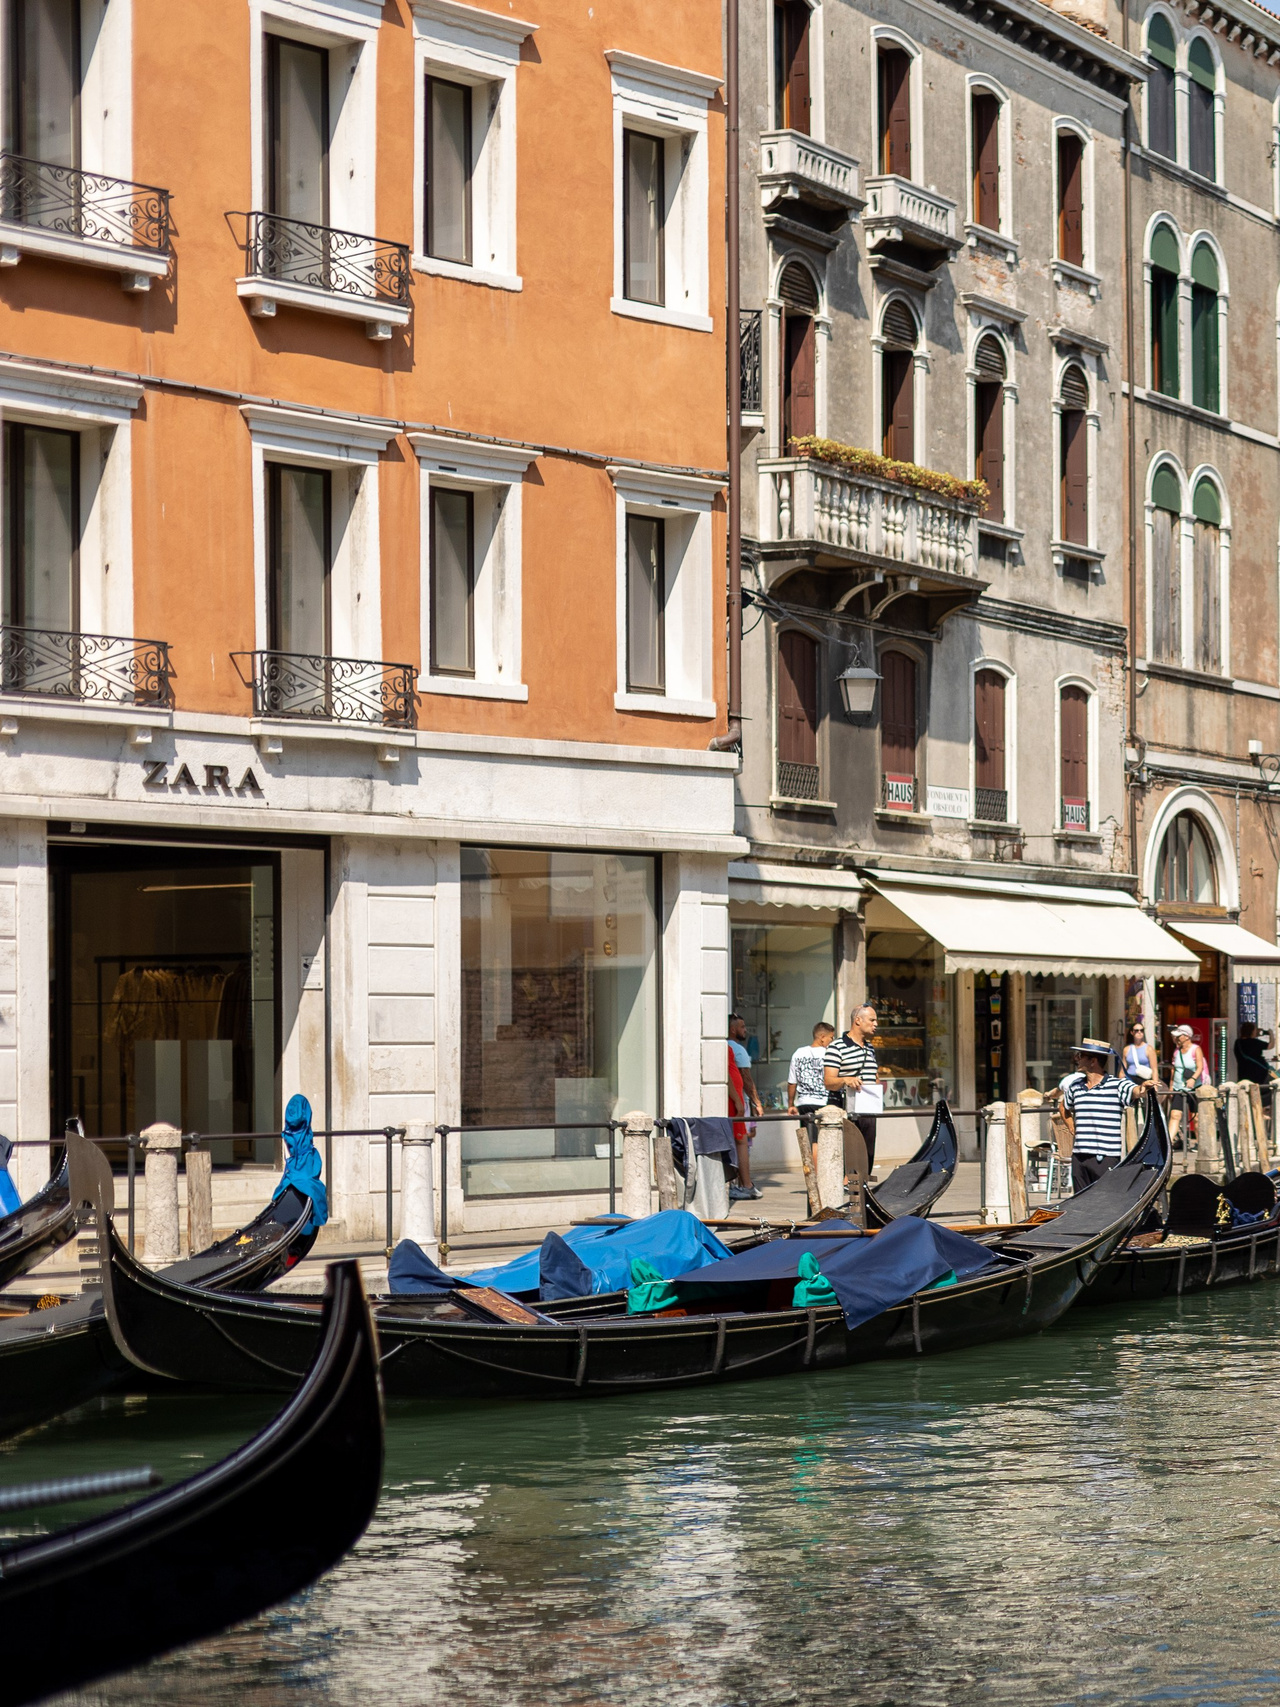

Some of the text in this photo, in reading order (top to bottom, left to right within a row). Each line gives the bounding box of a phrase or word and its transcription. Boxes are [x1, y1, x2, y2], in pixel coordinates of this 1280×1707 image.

[142, 760, 264, 791] ZARA
[887, 781, 912, 803] HAUS
[1064, 805, 1086, 824] HAUS
[1242, 985, 1252, 995] UN
[1240, 994, 1256, 1004] TOIT
[1240, 1004, 1256, 1014] POUR
[1240, 1013, 1256, 1023] TOUS
